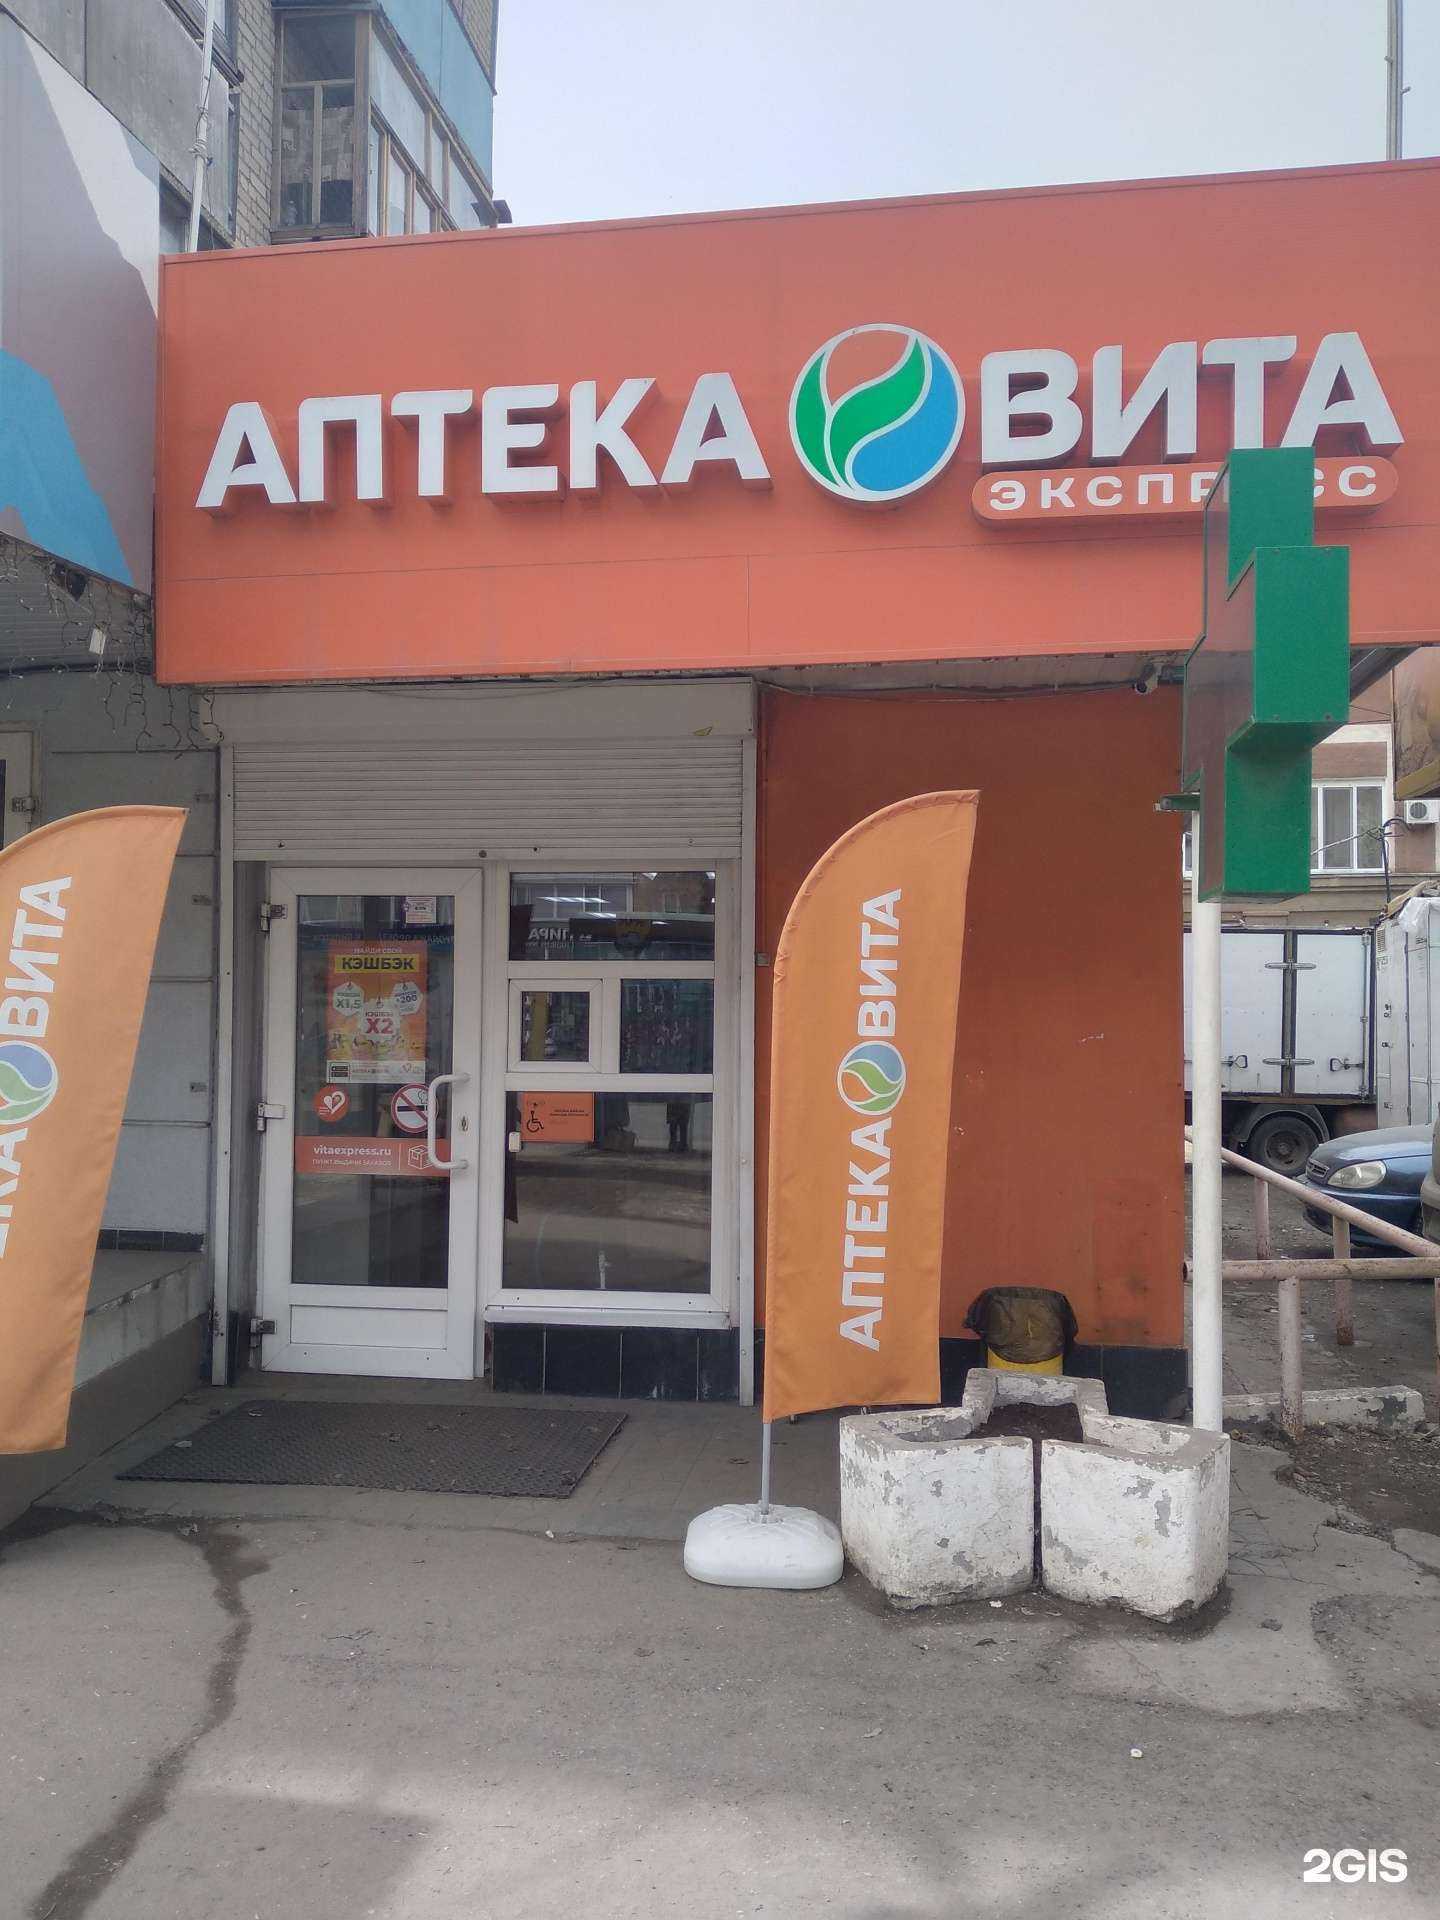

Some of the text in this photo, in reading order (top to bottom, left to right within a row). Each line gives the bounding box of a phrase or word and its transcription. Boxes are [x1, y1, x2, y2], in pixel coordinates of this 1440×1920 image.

[195, 331, 1404, 508] АПТЕКА ВИТА
[989, 465, 1377, 511] ЭКСПРС
[0, 877, 72, 1038] ВИТА
[342, 957, 415, 970] КЭШБЭК
[313, 1145, 392, 1157] vitaexpress.ru
[840, 888, 902, 1352] АПТЕКА ВИТА
